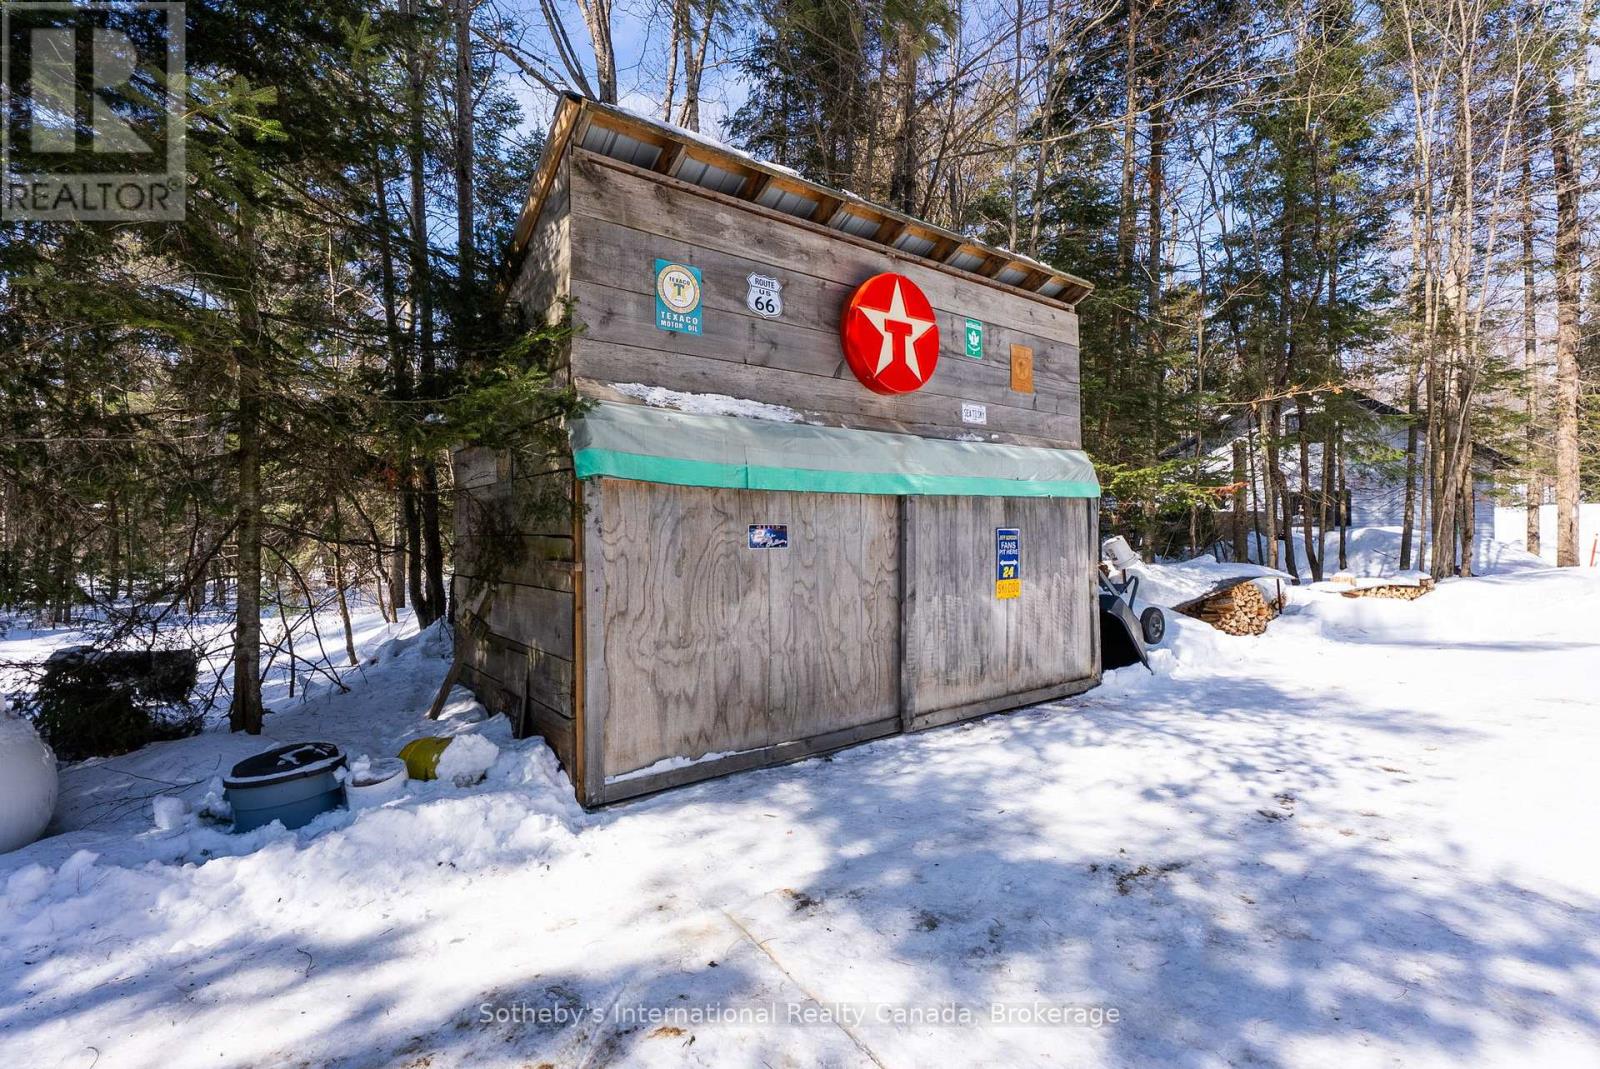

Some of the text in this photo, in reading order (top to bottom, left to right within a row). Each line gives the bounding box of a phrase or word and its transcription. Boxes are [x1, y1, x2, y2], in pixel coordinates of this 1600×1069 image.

[669, 276, 690, 285] TEXACO
[755, 277, 775, 289] ROUTE
[673, 283, 685, 297] T
[758, 288, 771, 297] US
[754, 296, 776, 314] 66
[660, 311, 698, 325] TEXACO
[660, 319, 683, 329] MOTOR
[885, 320, 913, 365] T
[1001, 541, 1016, 549] FANS
[1003, 566, 1014, 577] 24
